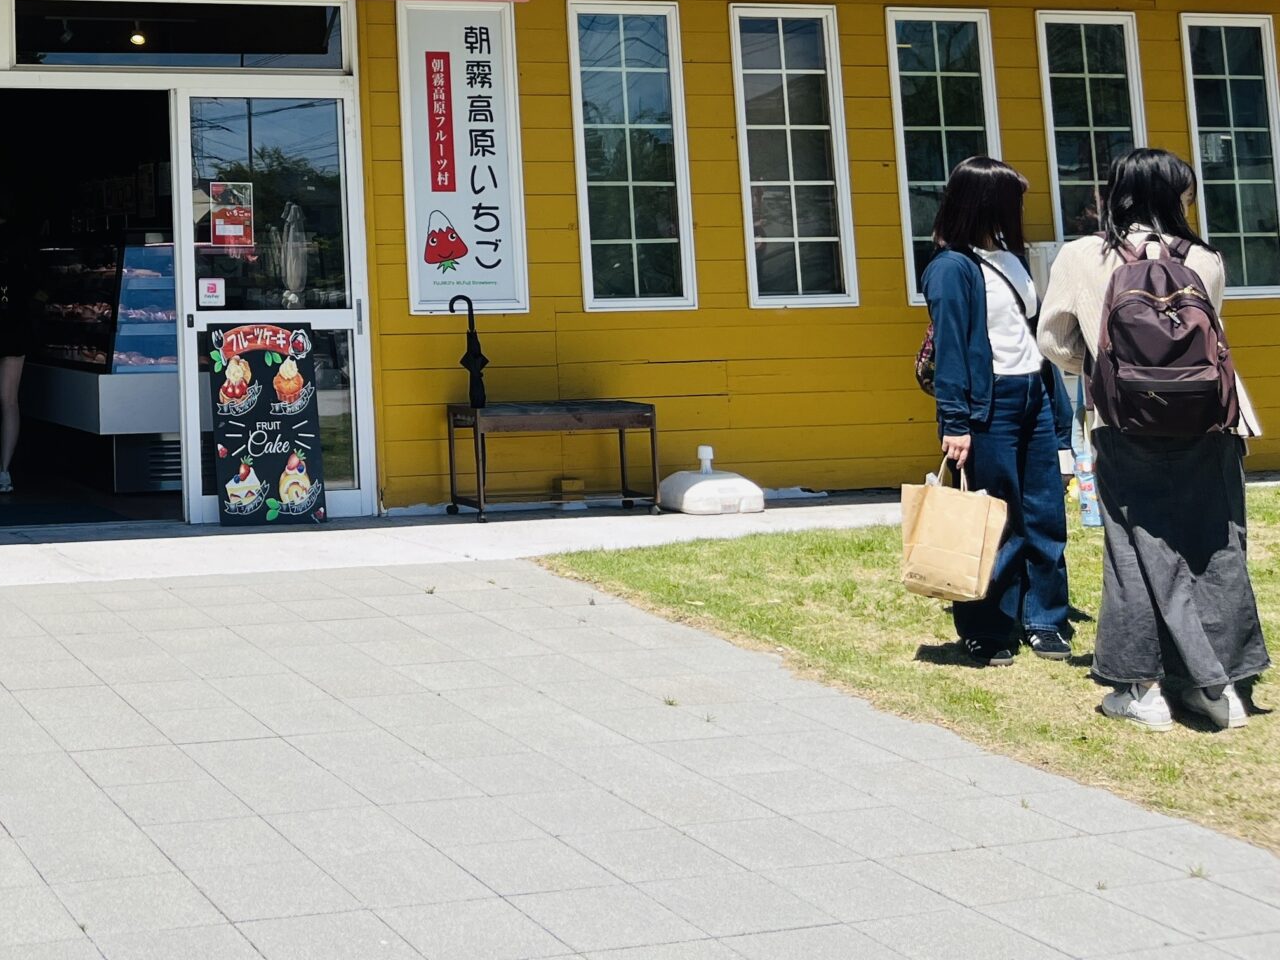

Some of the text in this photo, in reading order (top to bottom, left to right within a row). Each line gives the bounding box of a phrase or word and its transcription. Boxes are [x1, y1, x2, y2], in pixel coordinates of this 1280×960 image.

[431, 57, 450, 187] 朝霧高原フルーツ村
[464, 25, 503, 270] 朝霧高原いちご
[227, 328, 287, 353] フルーツケーキ
[256, 421, 281, 431] FRUIT
[247, 430, 290, 457] Cake
